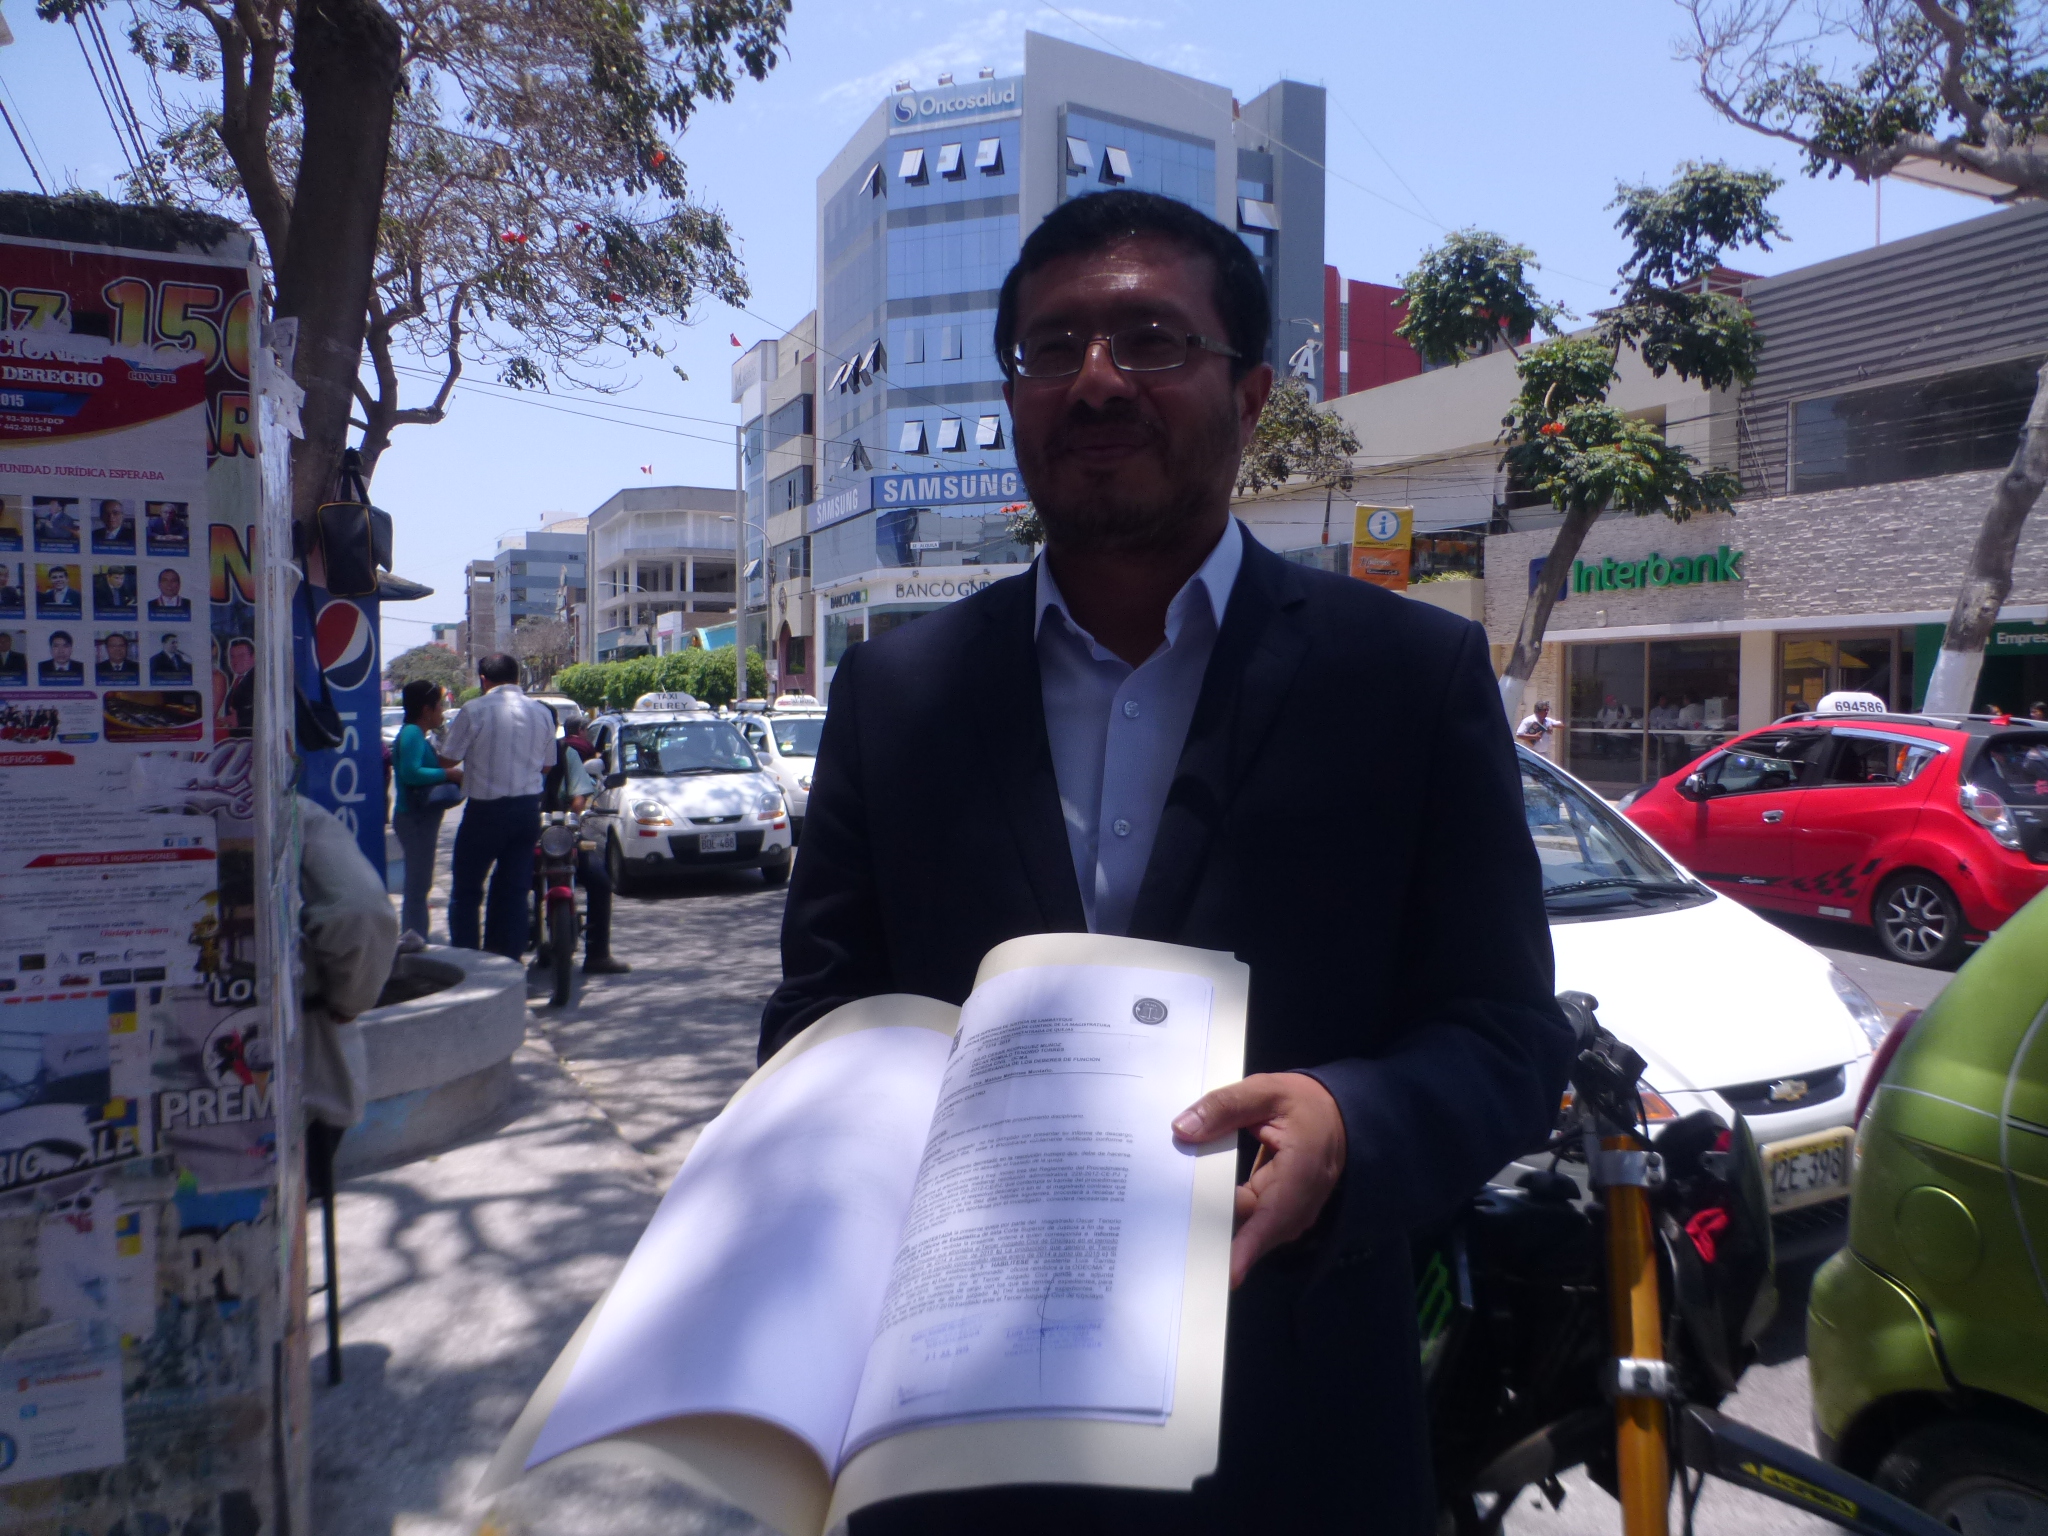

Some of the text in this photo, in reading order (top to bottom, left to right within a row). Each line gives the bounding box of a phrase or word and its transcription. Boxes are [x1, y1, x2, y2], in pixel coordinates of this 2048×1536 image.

[920, 82, 1015, 116] Oncosalud
[2, 365, 104, 387] DERECHO
[109, 469, 164, 481] ESPERABA
[884, 472, 1017, 503] SAMSUNG
[816, 488, 858, 524] SAMSUNG
[1573, 545, 1744, 593] Interbank
[896, 582, 955, 598] BANCO
[653, 702, 688, 710] EL REY
[1834, 700, 1883, 714] 694586
[103, 855, 109, 863] E
